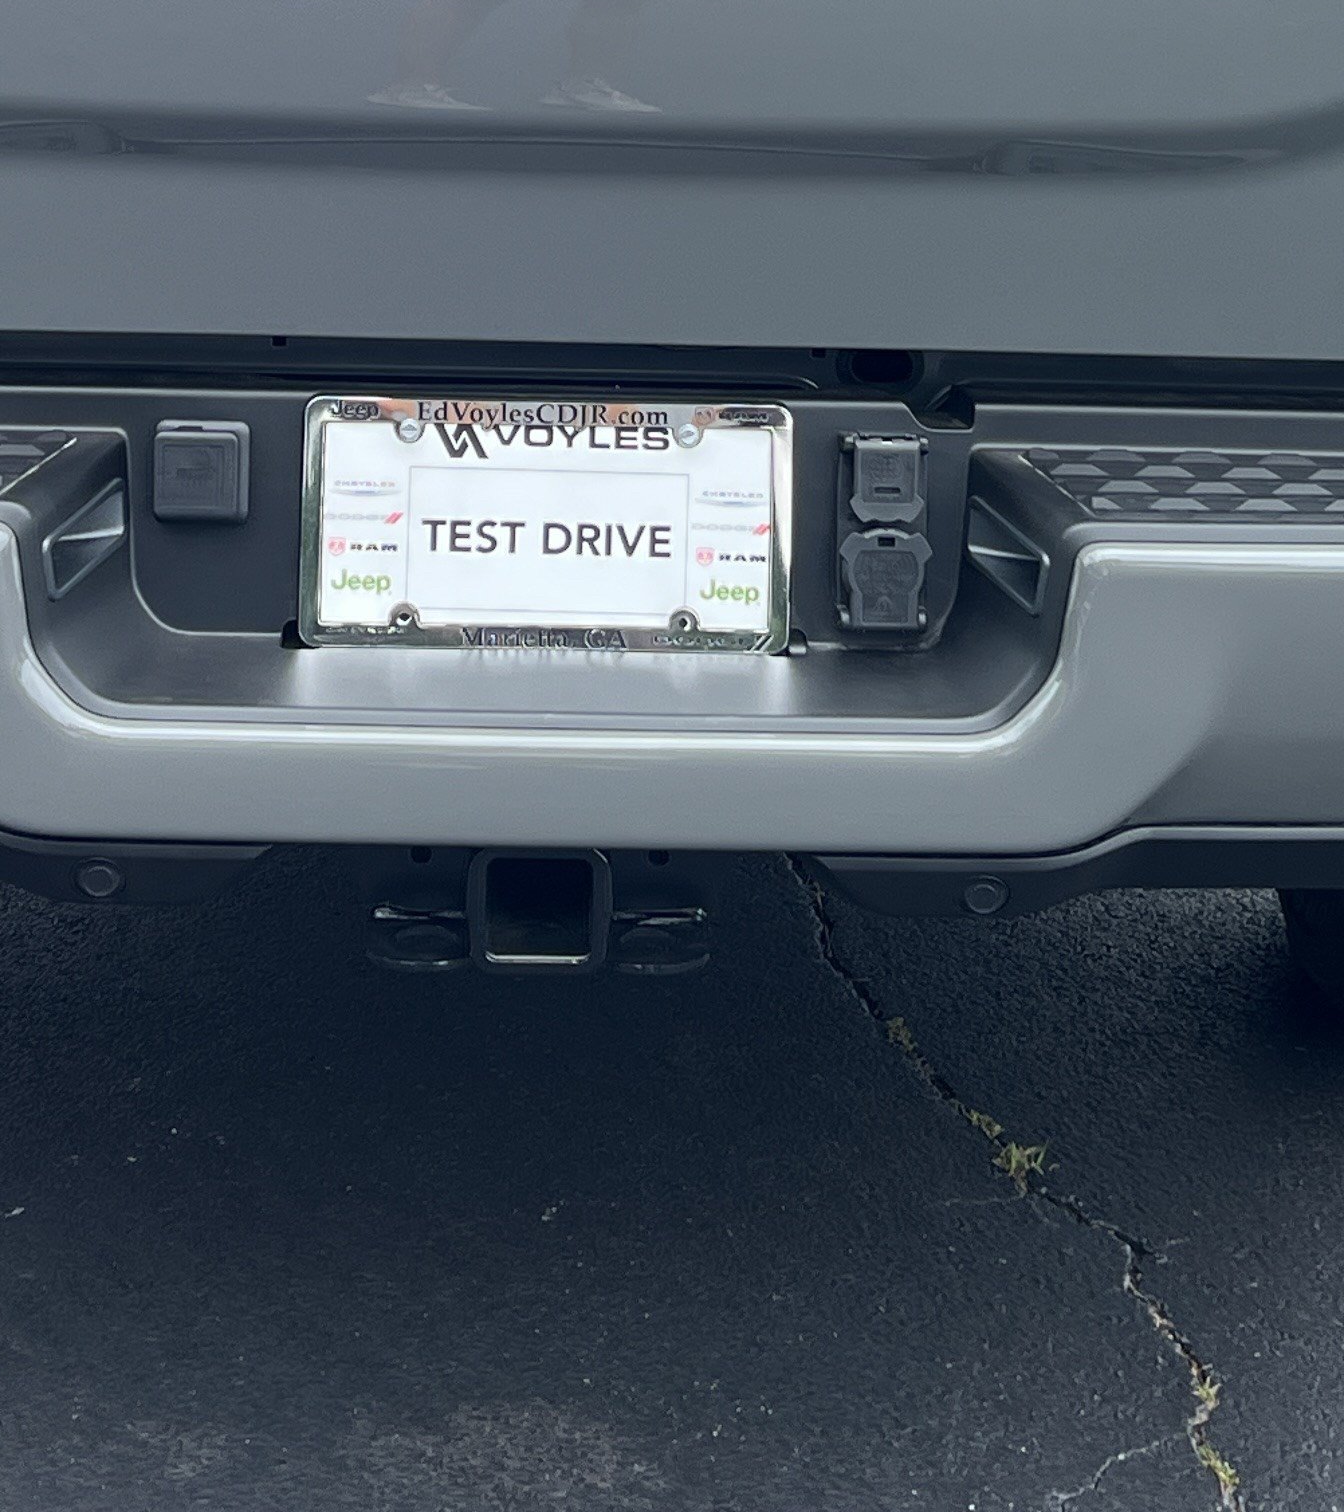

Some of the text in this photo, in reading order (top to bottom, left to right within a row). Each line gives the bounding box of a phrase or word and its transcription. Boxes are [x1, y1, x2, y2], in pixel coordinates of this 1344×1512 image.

[330, 400, 380, 420] Jeep
[417, 400, 669, 428] EdVoylesCDJR.com
[493, 424, 670, 451] VOYLES
[350, 542, 398, 552] RAM
[421, 518, 672, 559] TEST DRIVE
[719, 553, 767, 563] RAM
[331, 568, 392, 596] Jeep
[699, 579, 760, 606] Jeep
[584, 628, 628, 650] GA
